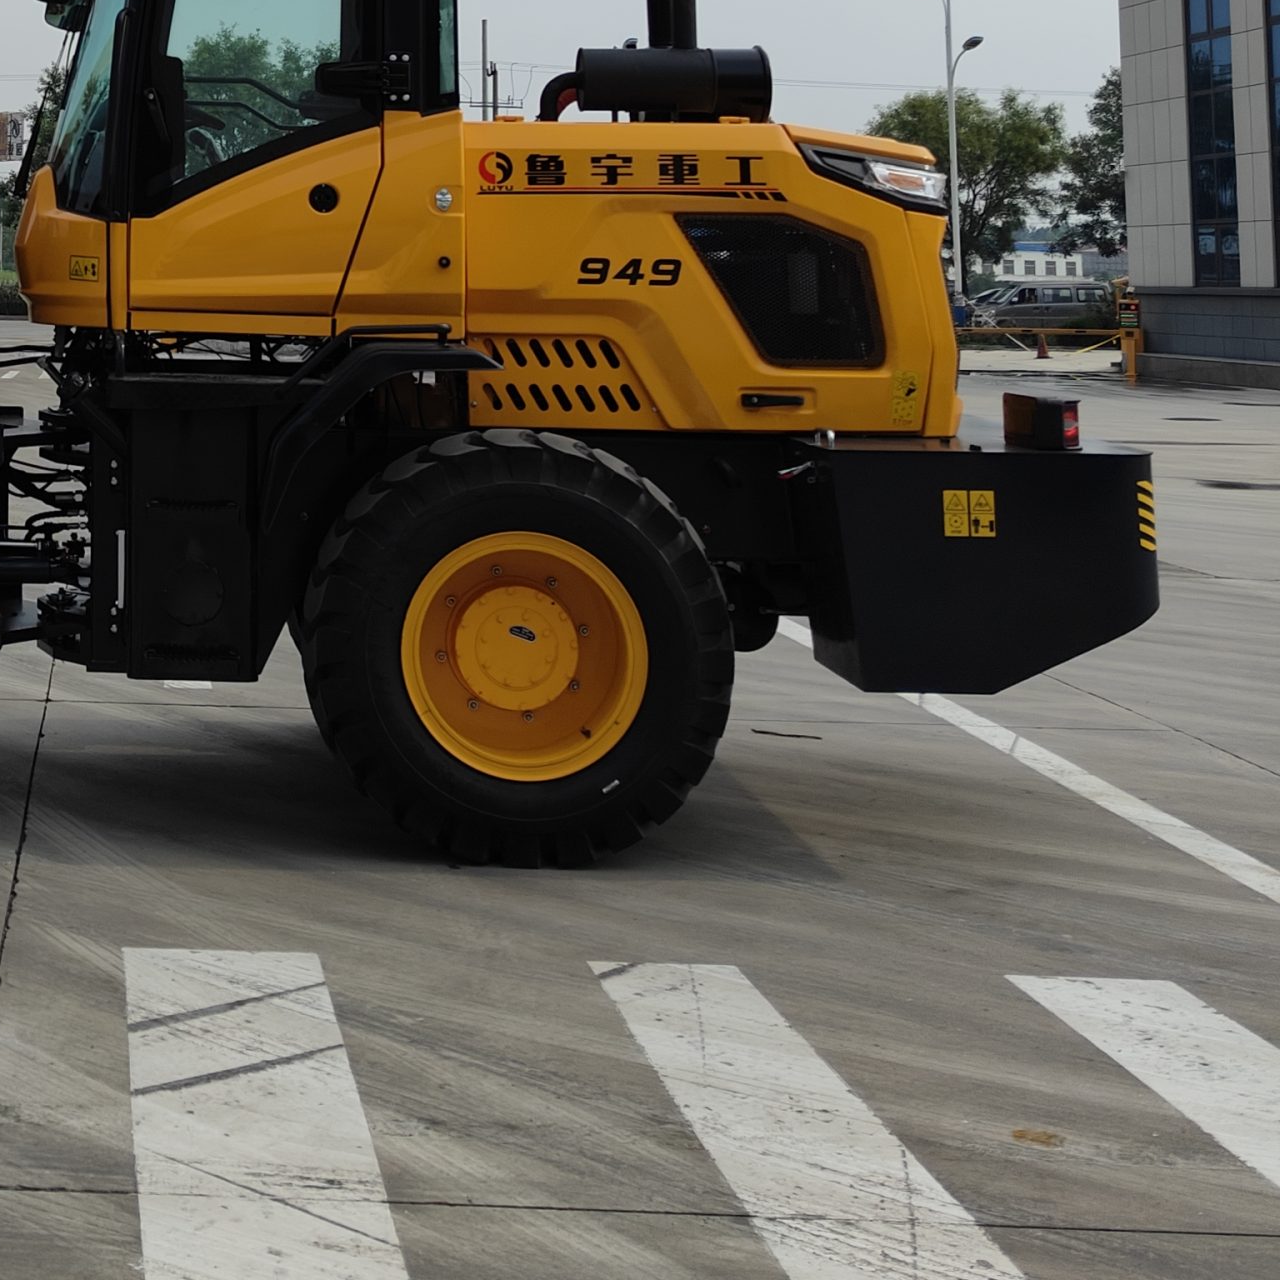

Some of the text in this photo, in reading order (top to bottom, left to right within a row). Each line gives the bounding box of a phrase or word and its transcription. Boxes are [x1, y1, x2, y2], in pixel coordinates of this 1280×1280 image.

[525, 154, 767, 186] 鲁宇重工
[479, 184, 514, 192] LUYU
[576, 256, 683, 286] 949
